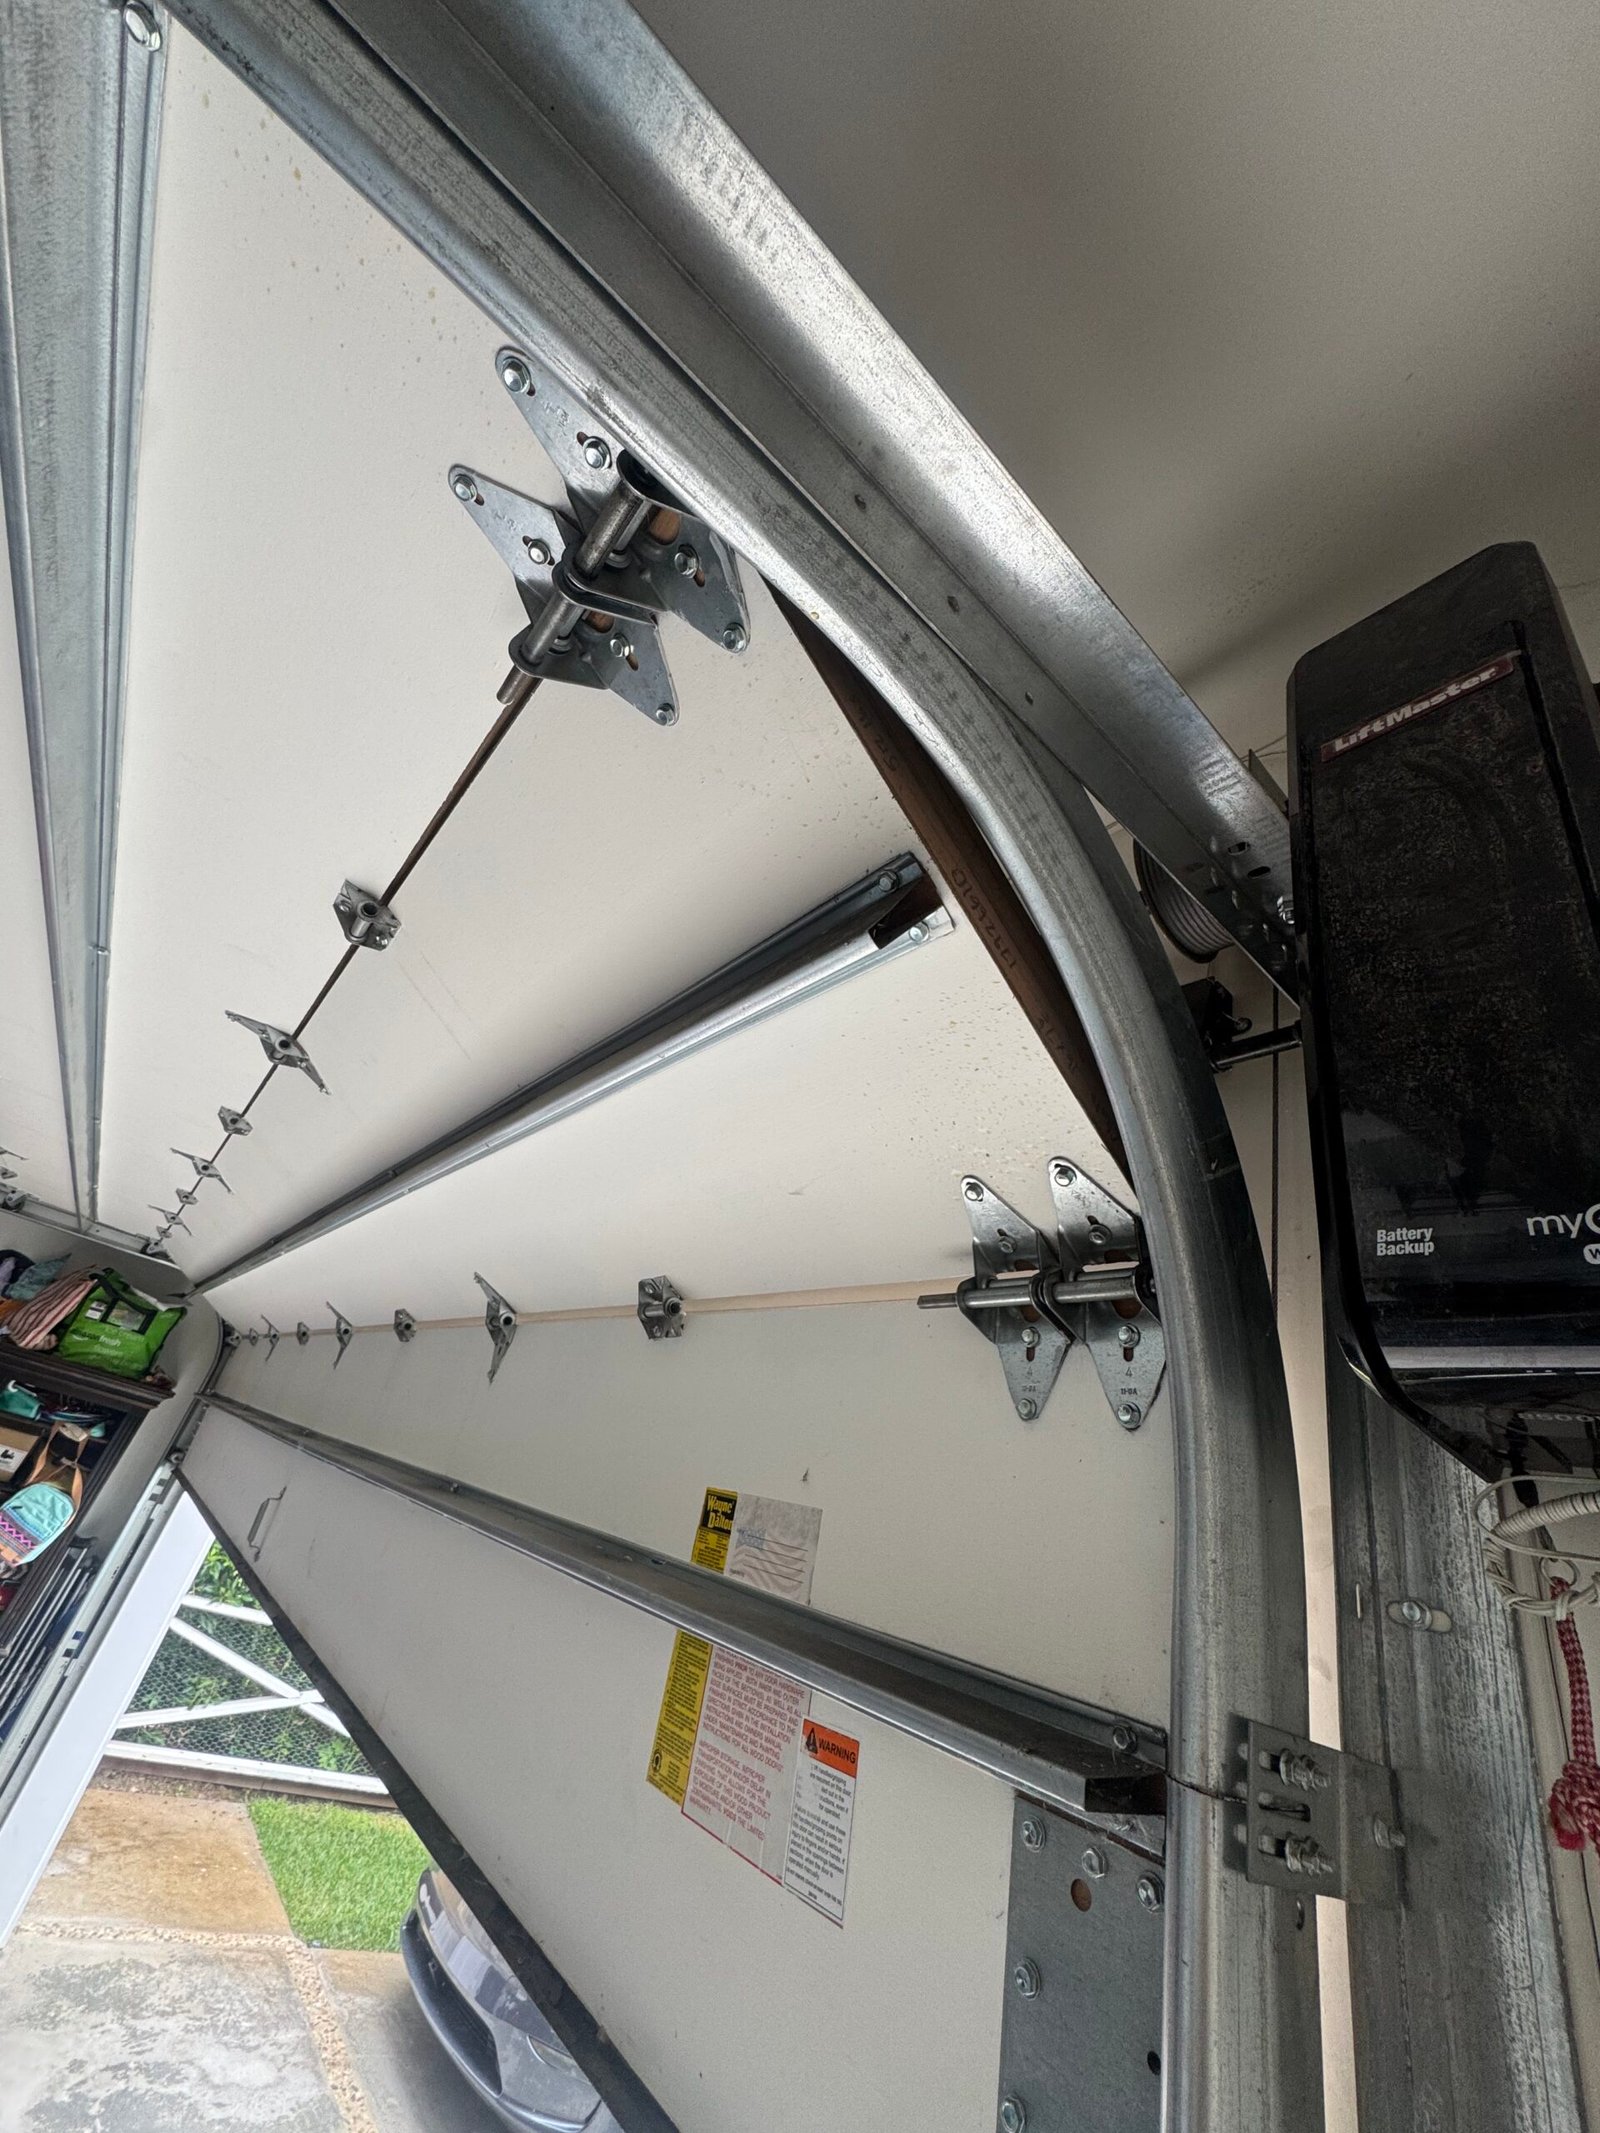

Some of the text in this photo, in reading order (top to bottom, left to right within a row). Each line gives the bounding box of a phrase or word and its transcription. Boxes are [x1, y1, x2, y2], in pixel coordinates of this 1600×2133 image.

[1334, 667, 1496, 752] LiftMaster
[1376, 1227, 1433, 1243] Battery
[1376, 1241, 1435, 1256] Backup
[1125, 1367, 1133, 1377] 4
[707, 1494, 733, 1515] Wayne
[818, 1738, 857, 1765] WARNING
